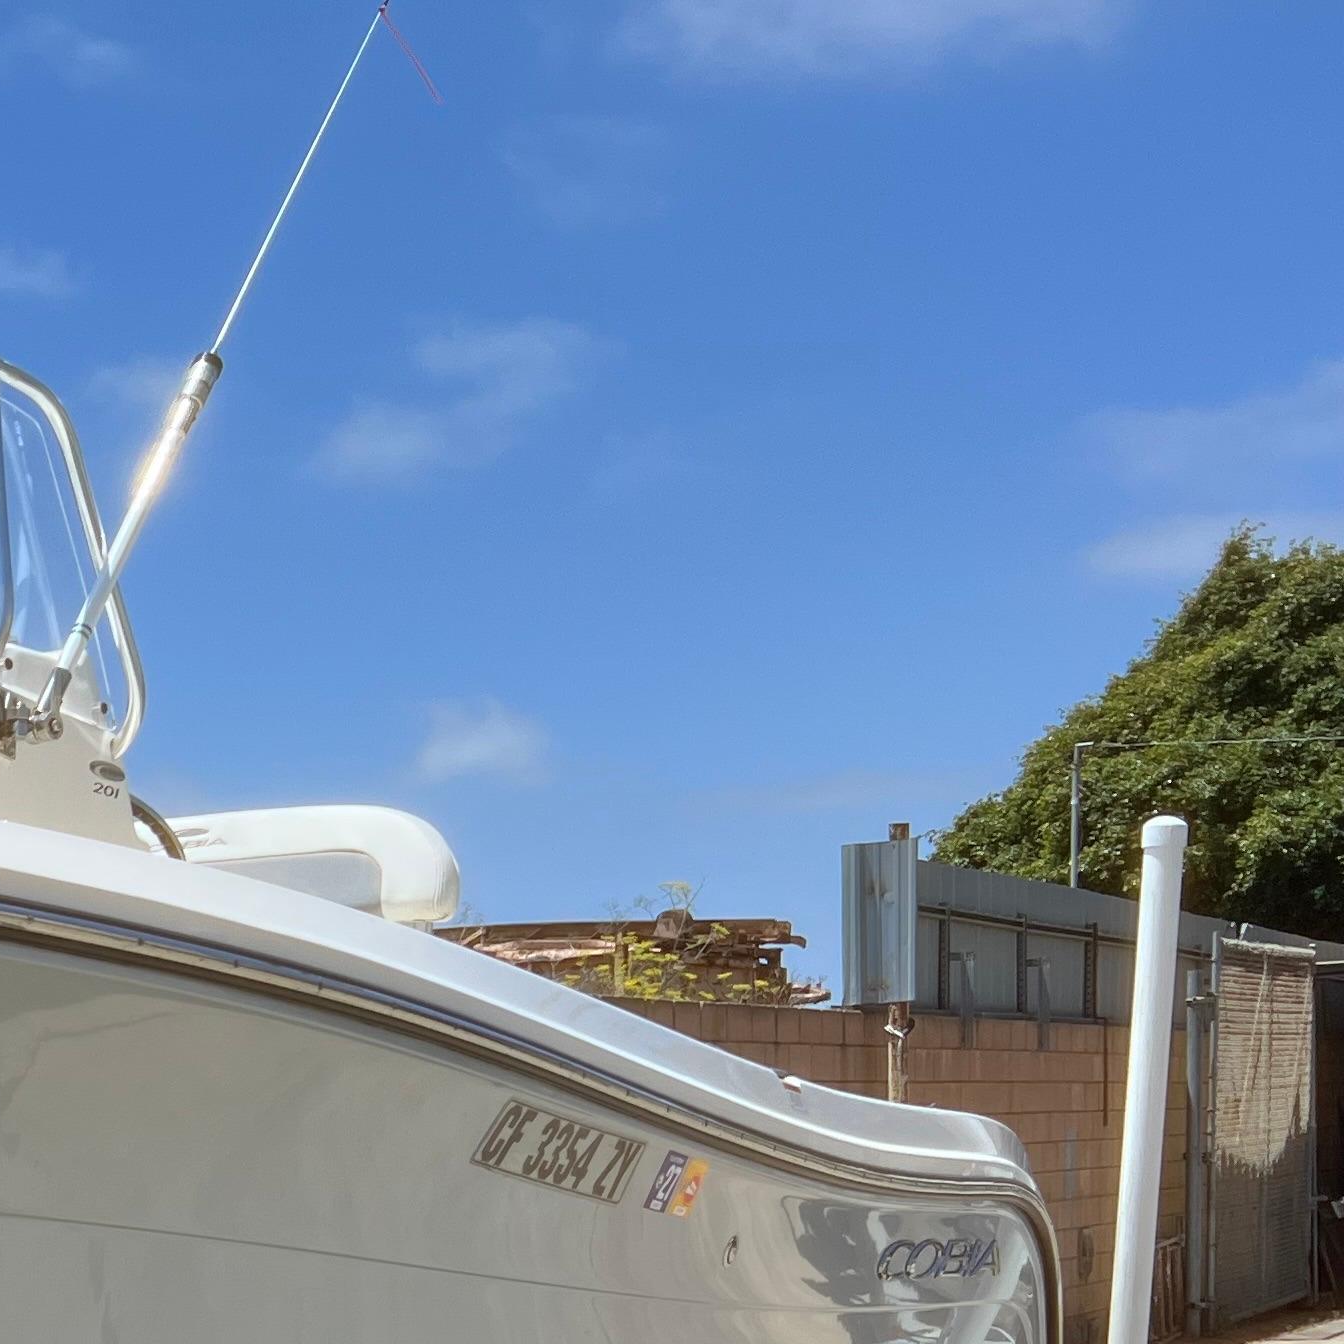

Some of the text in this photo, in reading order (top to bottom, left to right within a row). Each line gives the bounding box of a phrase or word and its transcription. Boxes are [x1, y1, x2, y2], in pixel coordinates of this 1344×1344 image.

[93, 782, 119, 799] 201
[481, 1105, 640, 1199] CF 3354 ZY
[877, 1239, 1000, 1280] COBIA
